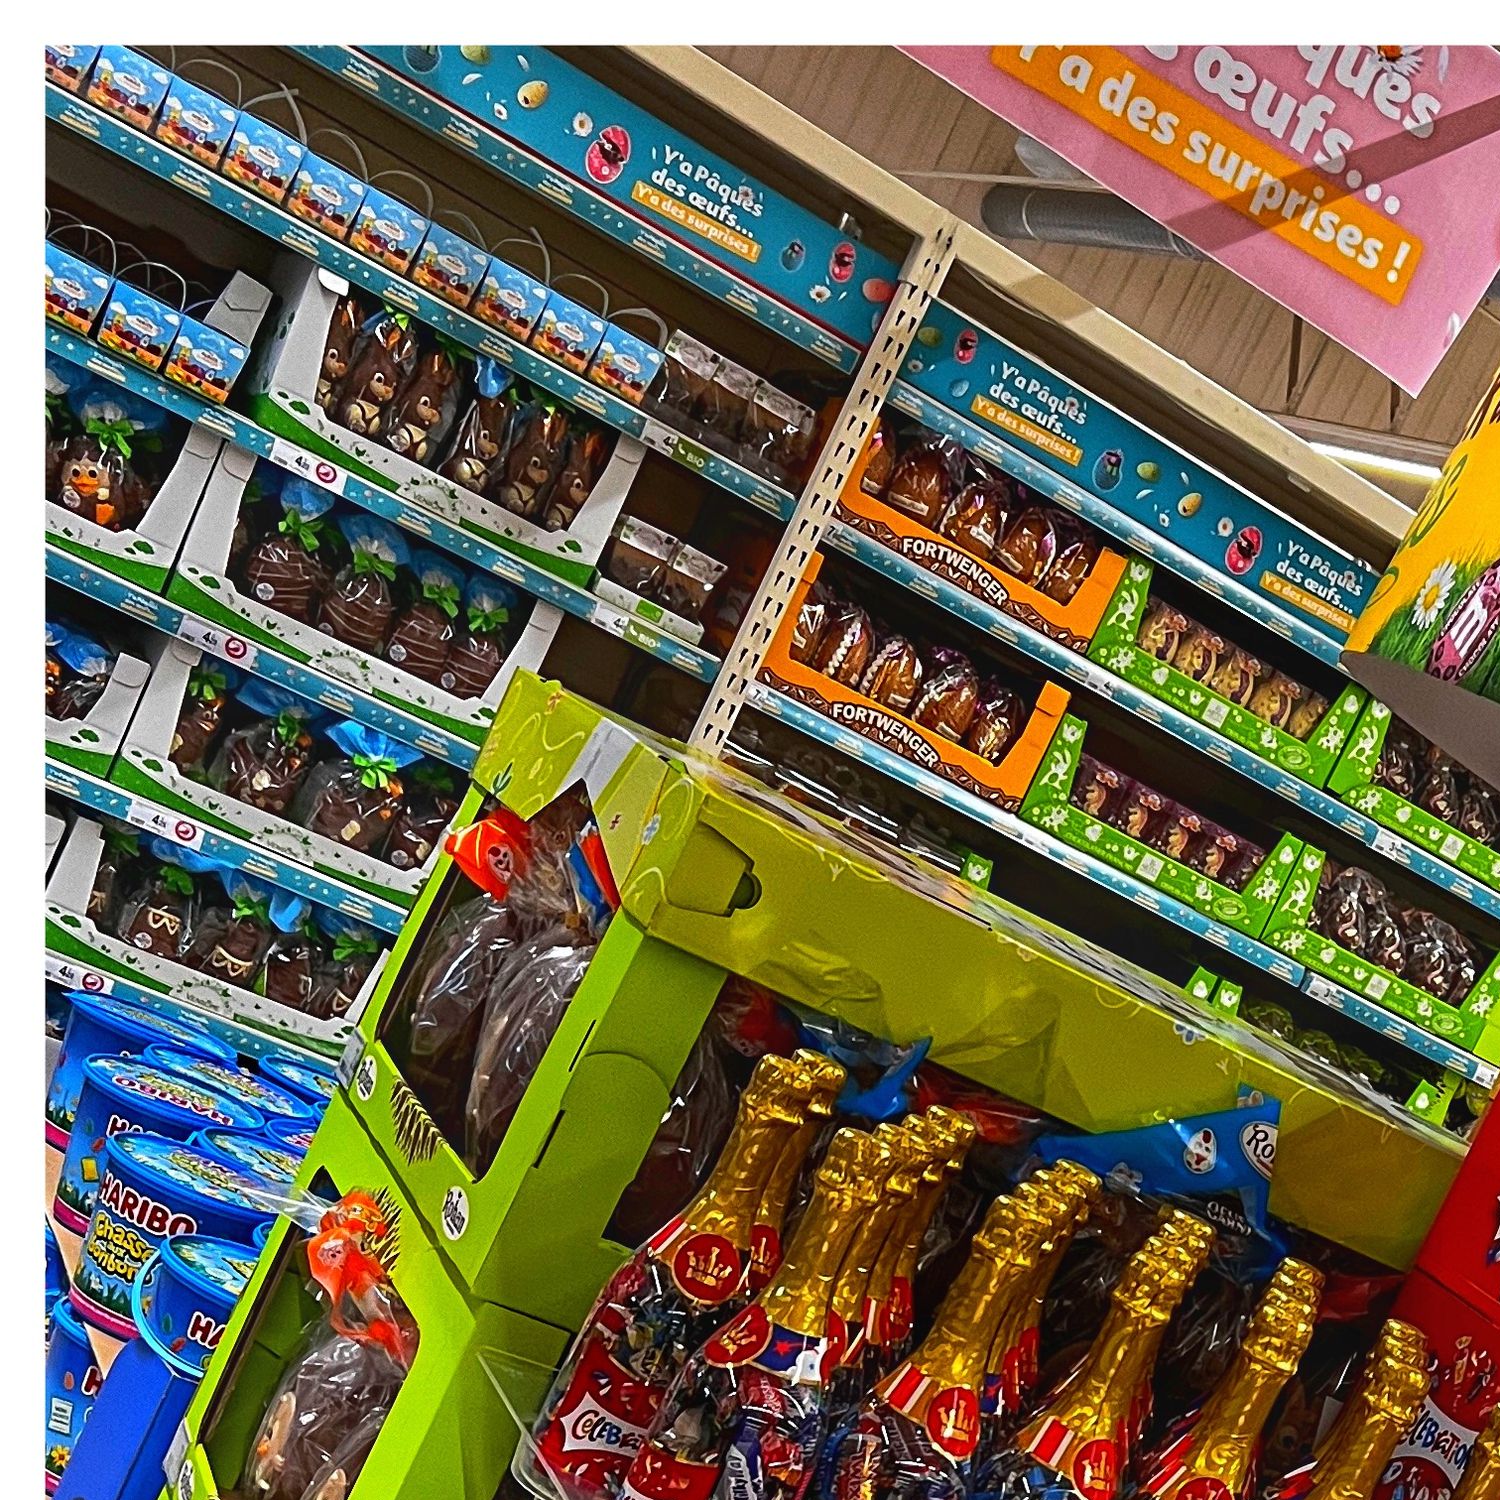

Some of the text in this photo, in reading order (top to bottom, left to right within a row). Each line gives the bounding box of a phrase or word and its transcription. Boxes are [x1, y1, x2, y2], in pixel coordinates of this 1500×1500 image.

[651, 168, 687, 197] des
[1099, 72, 1180, 145] des
[1183, 131, 1383, 269] surprises
[990, 383, 1019, 408] des
[903, 538, 1008, 605] FORTWENGER
[1277, 560, 1303, 583] des
[833, 703, 938, 768] FORTWENGER
[101, 1175, 196, 1236] HARIBO
